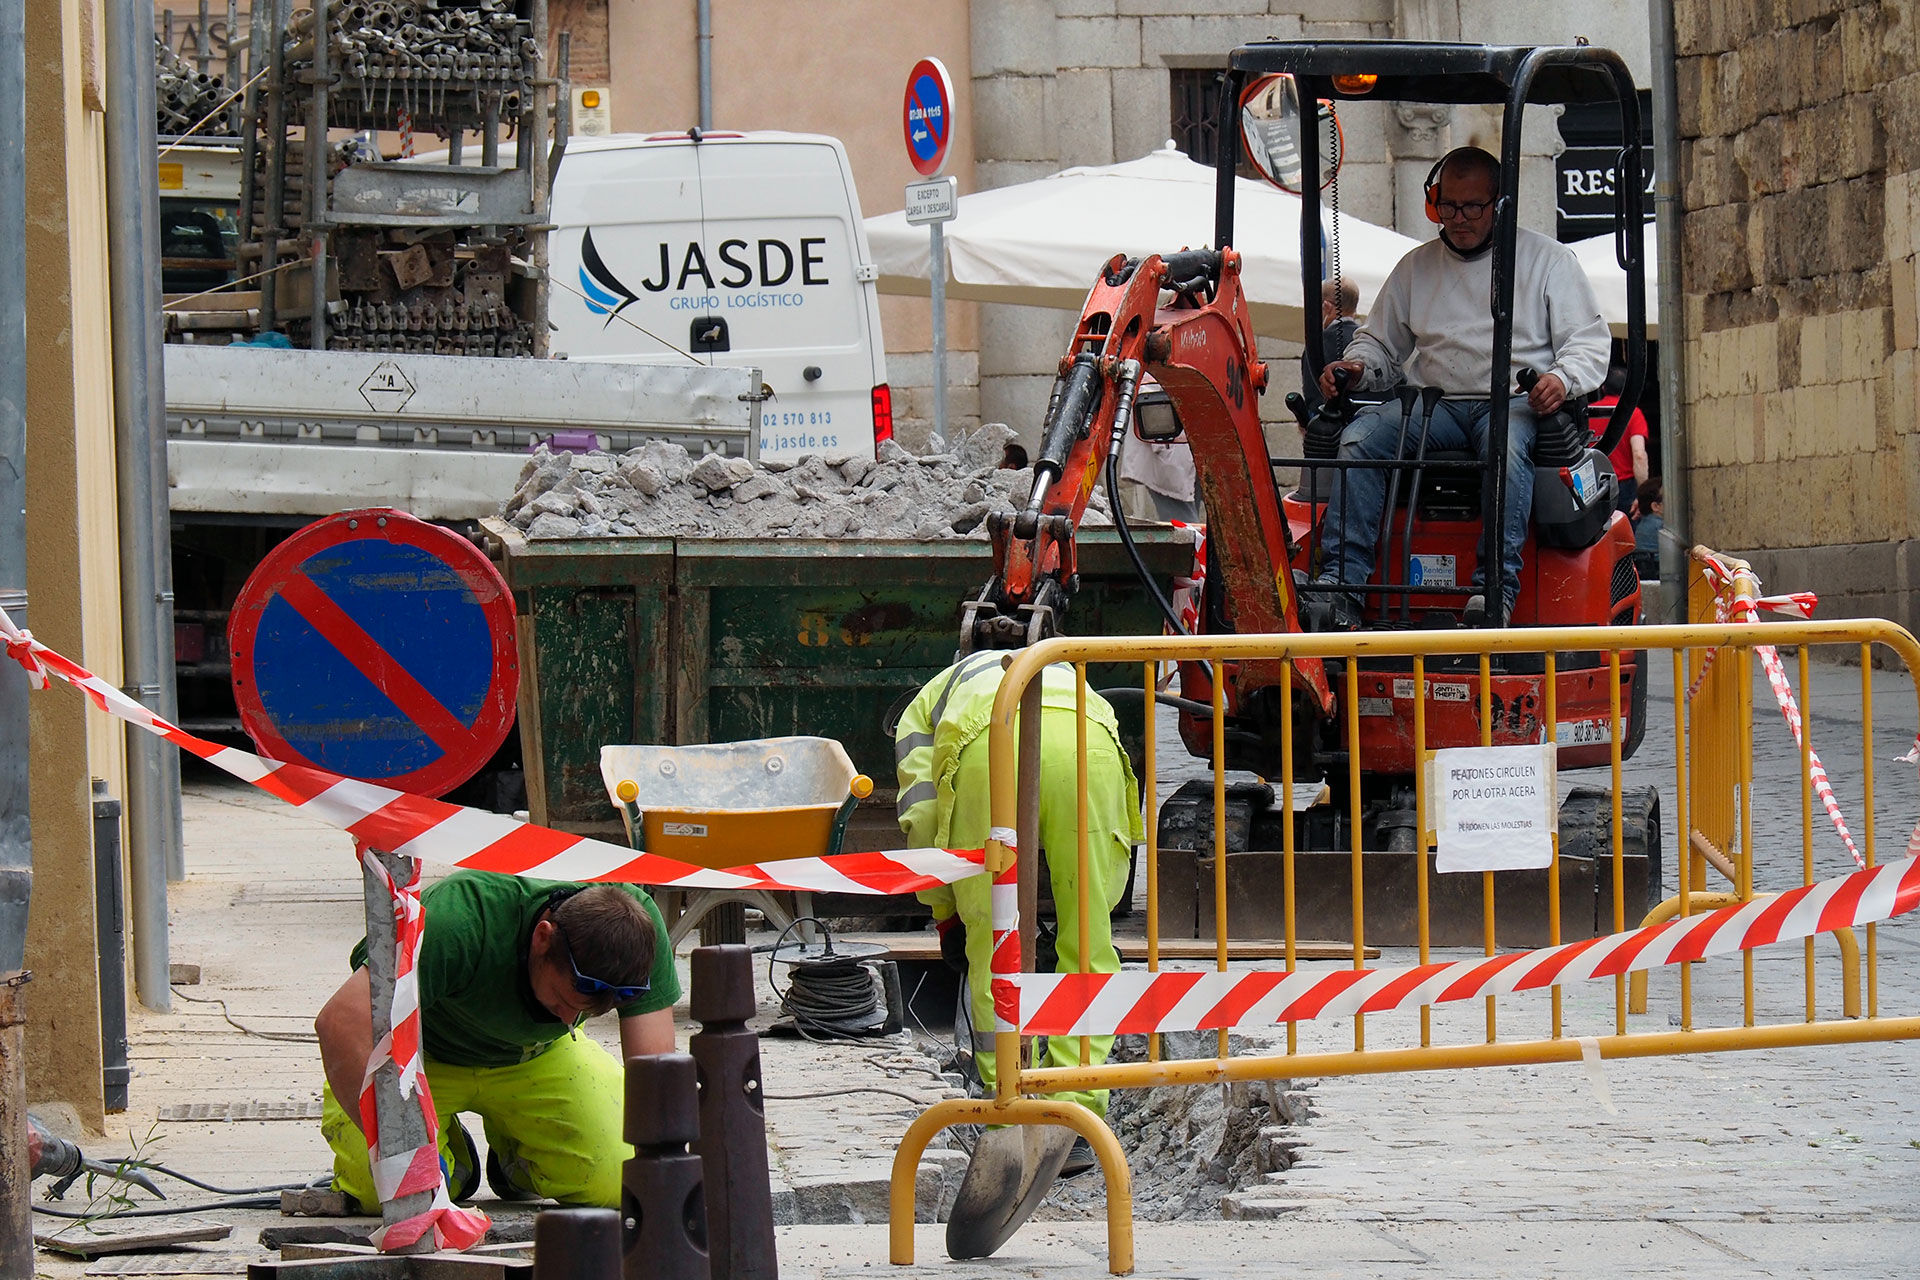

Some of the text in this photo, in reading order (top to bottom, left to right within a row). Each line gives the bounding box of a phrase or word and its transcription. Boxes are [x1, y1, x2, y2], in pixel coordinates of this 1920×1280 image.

[923, 107, 928, 119] A
[1562, 167, 1655, 196] RES
[917, 188, 940, 200] EXCEPTO
[907, 200, 950, 216] CARGA Y DESCARGA
[641, 237, 830, 293] JASDE
[670, 291, 804, 310] GRUPO LOGÍSTICO
[783, 412, 804, 426] 570
[810, 411, 831, 425] 813
[1451, 766, 1536, 780] PEATONES CIRCULEN
[1452, 786, 1536, 800] POR LA OTRA ACERA
[1458, 820, 1533, 832] PERDONEN LAS MOLESTIAS
